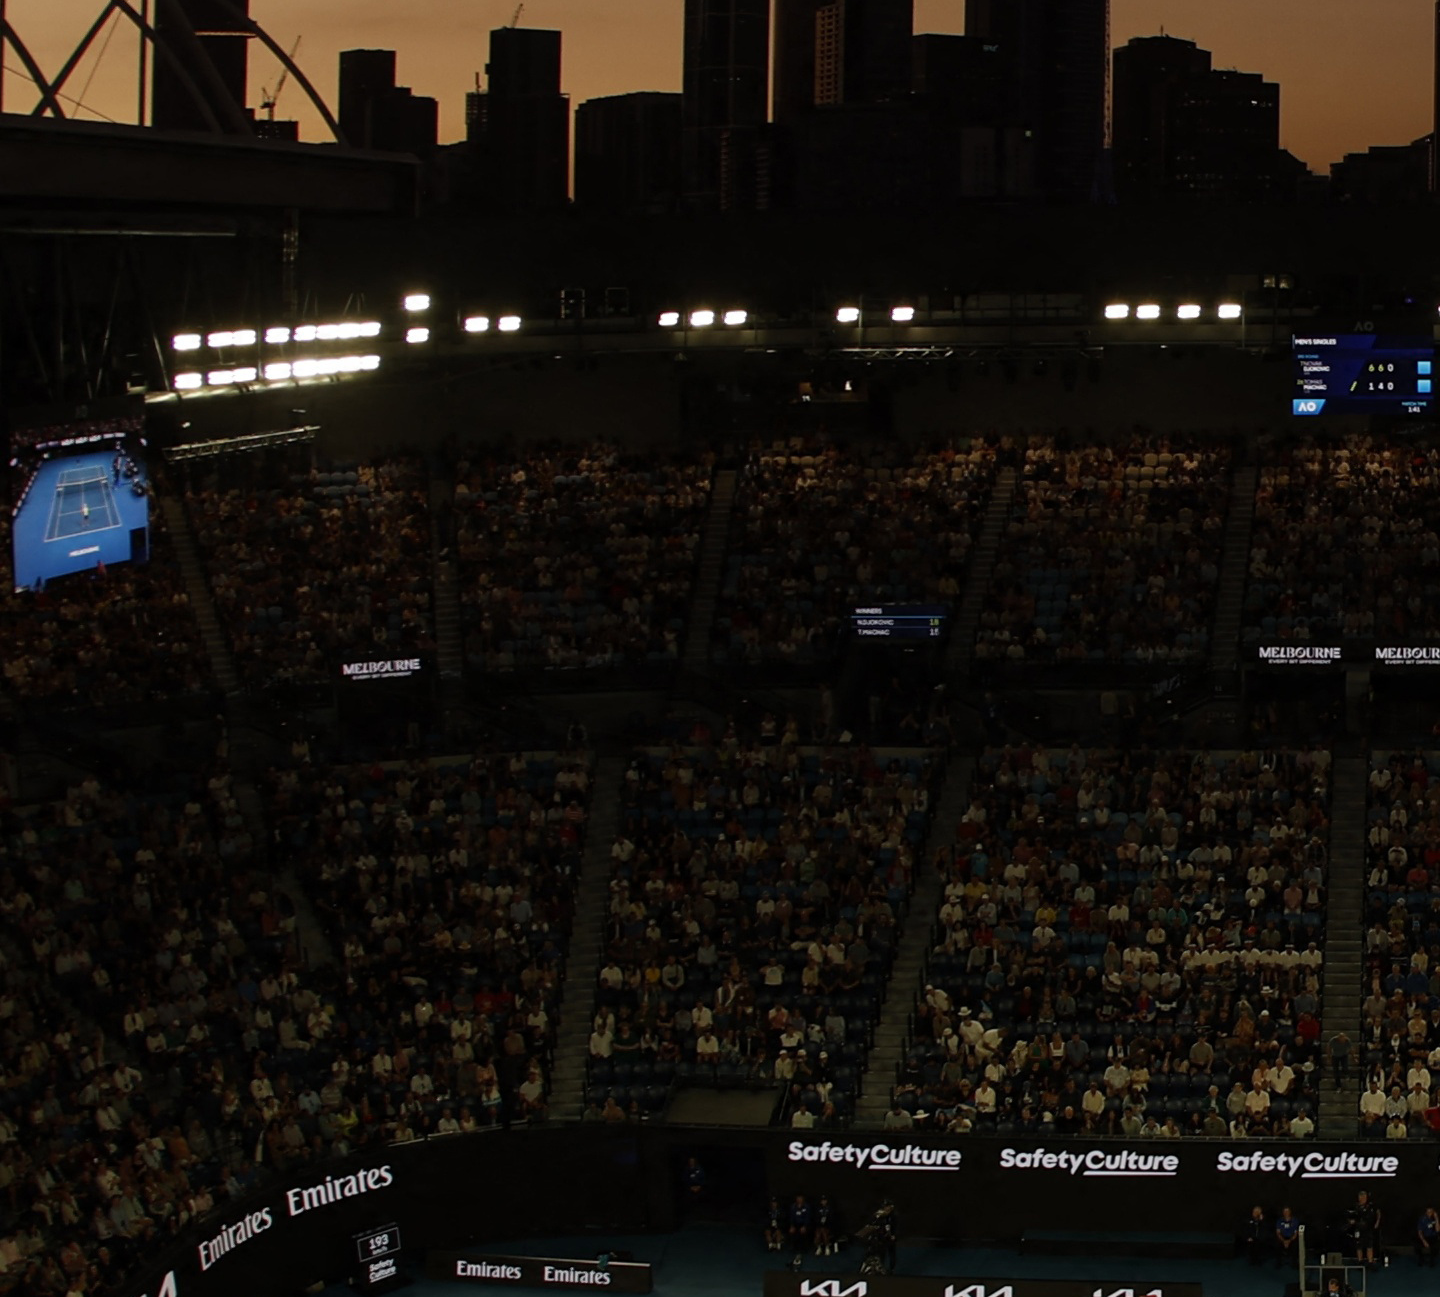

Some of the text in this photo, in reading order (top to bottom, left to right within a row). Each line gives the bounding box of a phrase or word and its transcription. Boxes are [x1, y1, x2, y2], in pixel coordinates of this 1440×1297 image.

[1368, 363, 1394, 372] 6 6 0
[1259, 647, 1341, 659] MELBOURNE
[343, 659, 420, 675] MELBOURNE
[788, 1141, 962, 1170] SafetyCulture
[999, 1148, 1179, 1175] SafetyCulture
[1216, 1152, 1399, 1178] SafetyCulture
[199, 1164, 393, 1271] Emirates Emirates
[369, 1234, 389, 1250] 193
[456, 1260, 611, 1285] Emirates Emirates
